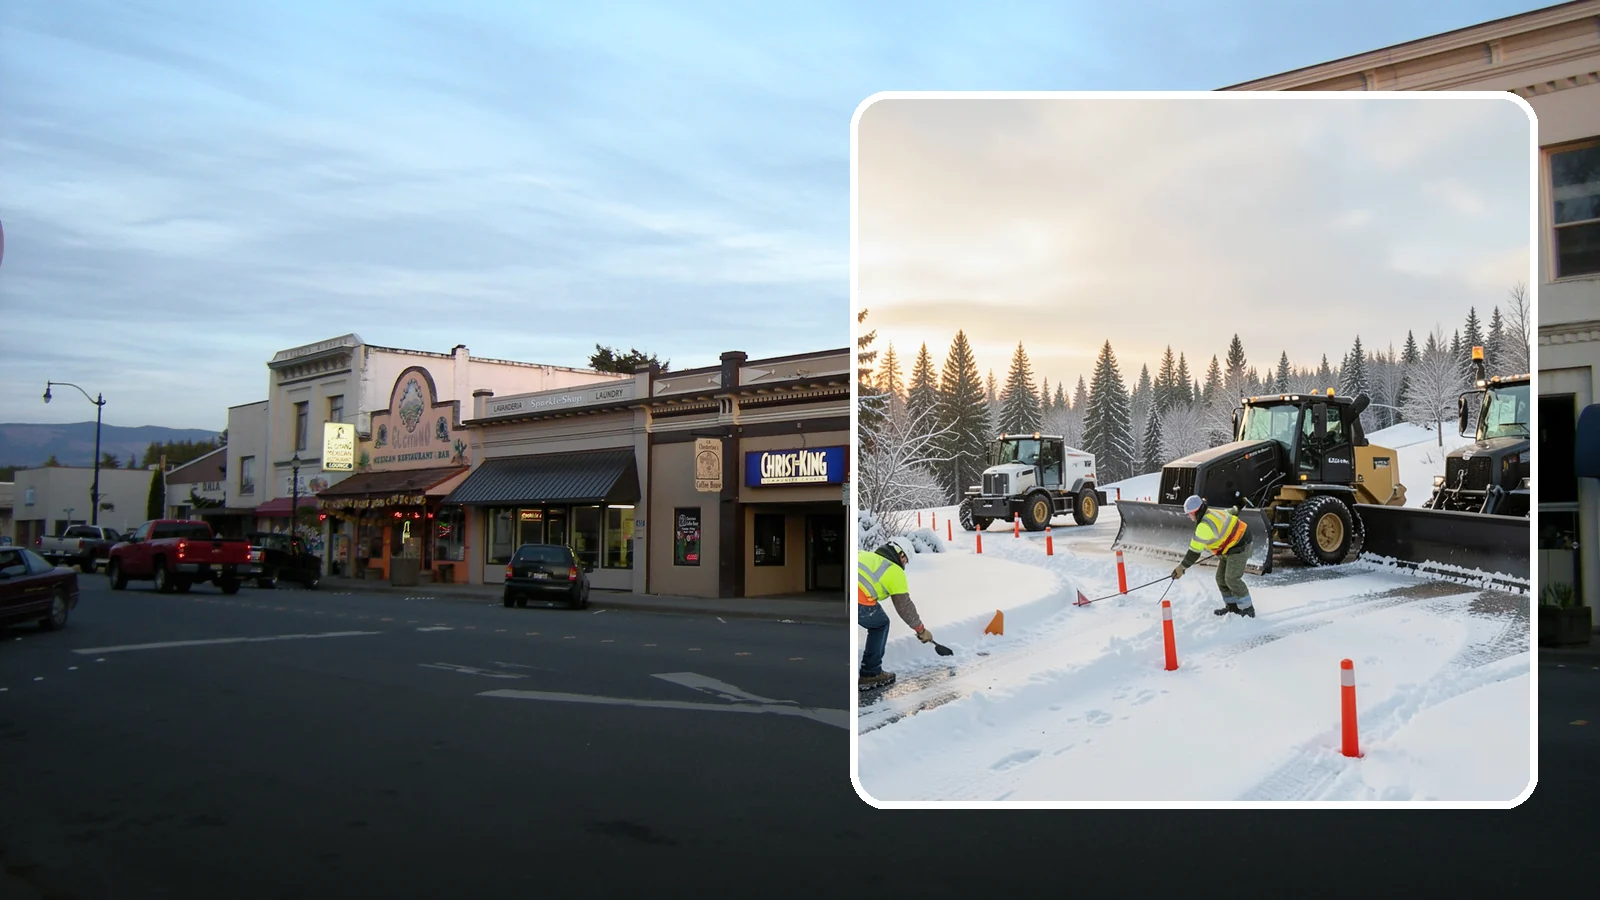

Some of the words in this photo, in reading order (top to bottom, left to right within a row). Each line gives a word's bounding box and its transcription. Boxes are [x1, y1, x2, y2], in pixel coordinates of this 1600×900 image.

[595, 389, 624, 400] LAUNDRY
[530, 397, 560, 408] Sparkle
[561, 394, 583, 405] Shop
[493, 402, 523, 413] LAVANDERIA
[326, 449, 353, 457] MEXICAN
[373, 454, 396, 464] MEXICAN
[397, 451, 433, 462] RESTAURANT
[437, 450, 450, 459] BAR
[760, 451, 797, 478] CHRIST
[799, 449, 827, 476] KING
[696, 480, 709, 489] Coffee
